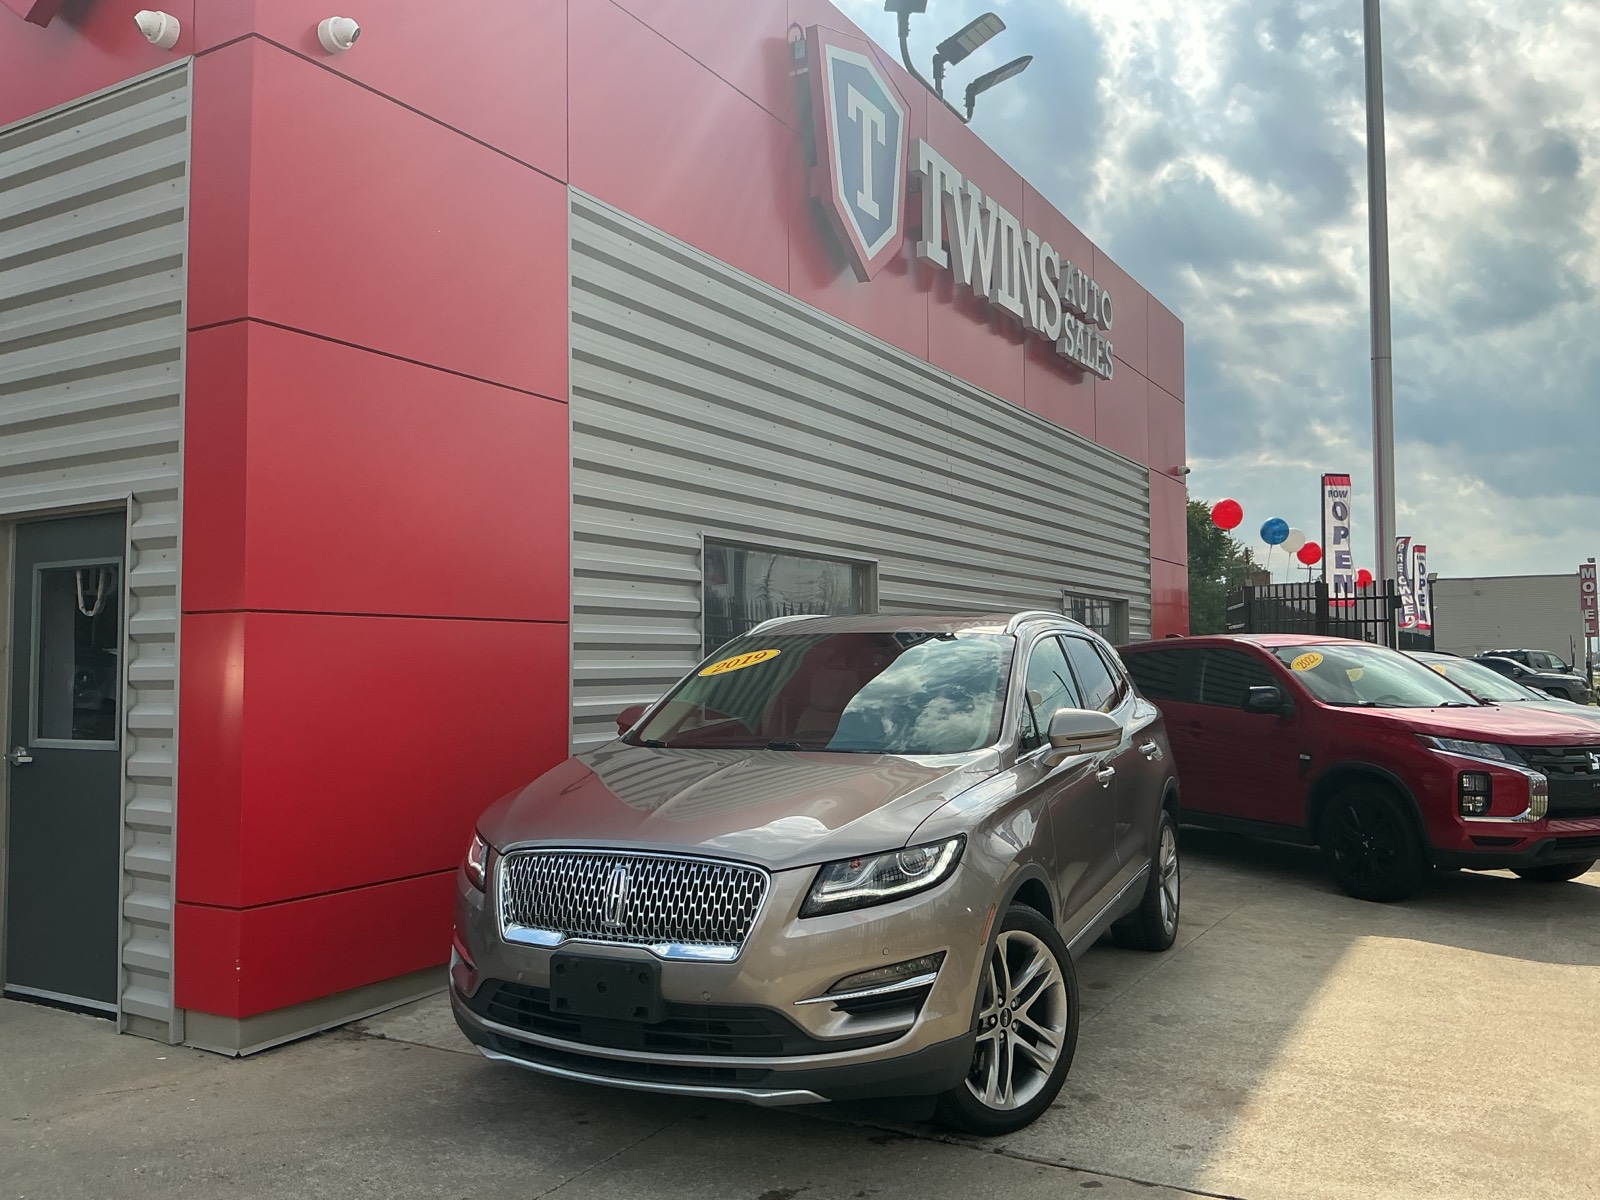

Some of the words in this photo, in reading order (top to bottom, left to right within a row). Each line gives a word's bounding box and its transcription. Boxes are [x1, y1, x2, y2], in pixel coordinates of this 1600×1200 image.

[847, 83, 886, 221] T
[911, 138, 1061, 341] TWINS
[1060, 260, 1113, 331] AUTO
[1058, 312, 1114, 381] SALES
[1327, 489, 1349, 499] NOW
[1331, 501, 1353, 594] OPEN
[1418, 562, 1428, 622] OPEN
[1580, 567, 1595, 634] MOTEL
[711, 651, 768, 673] 2019
[1296, 654, 1319, 669] 2022
